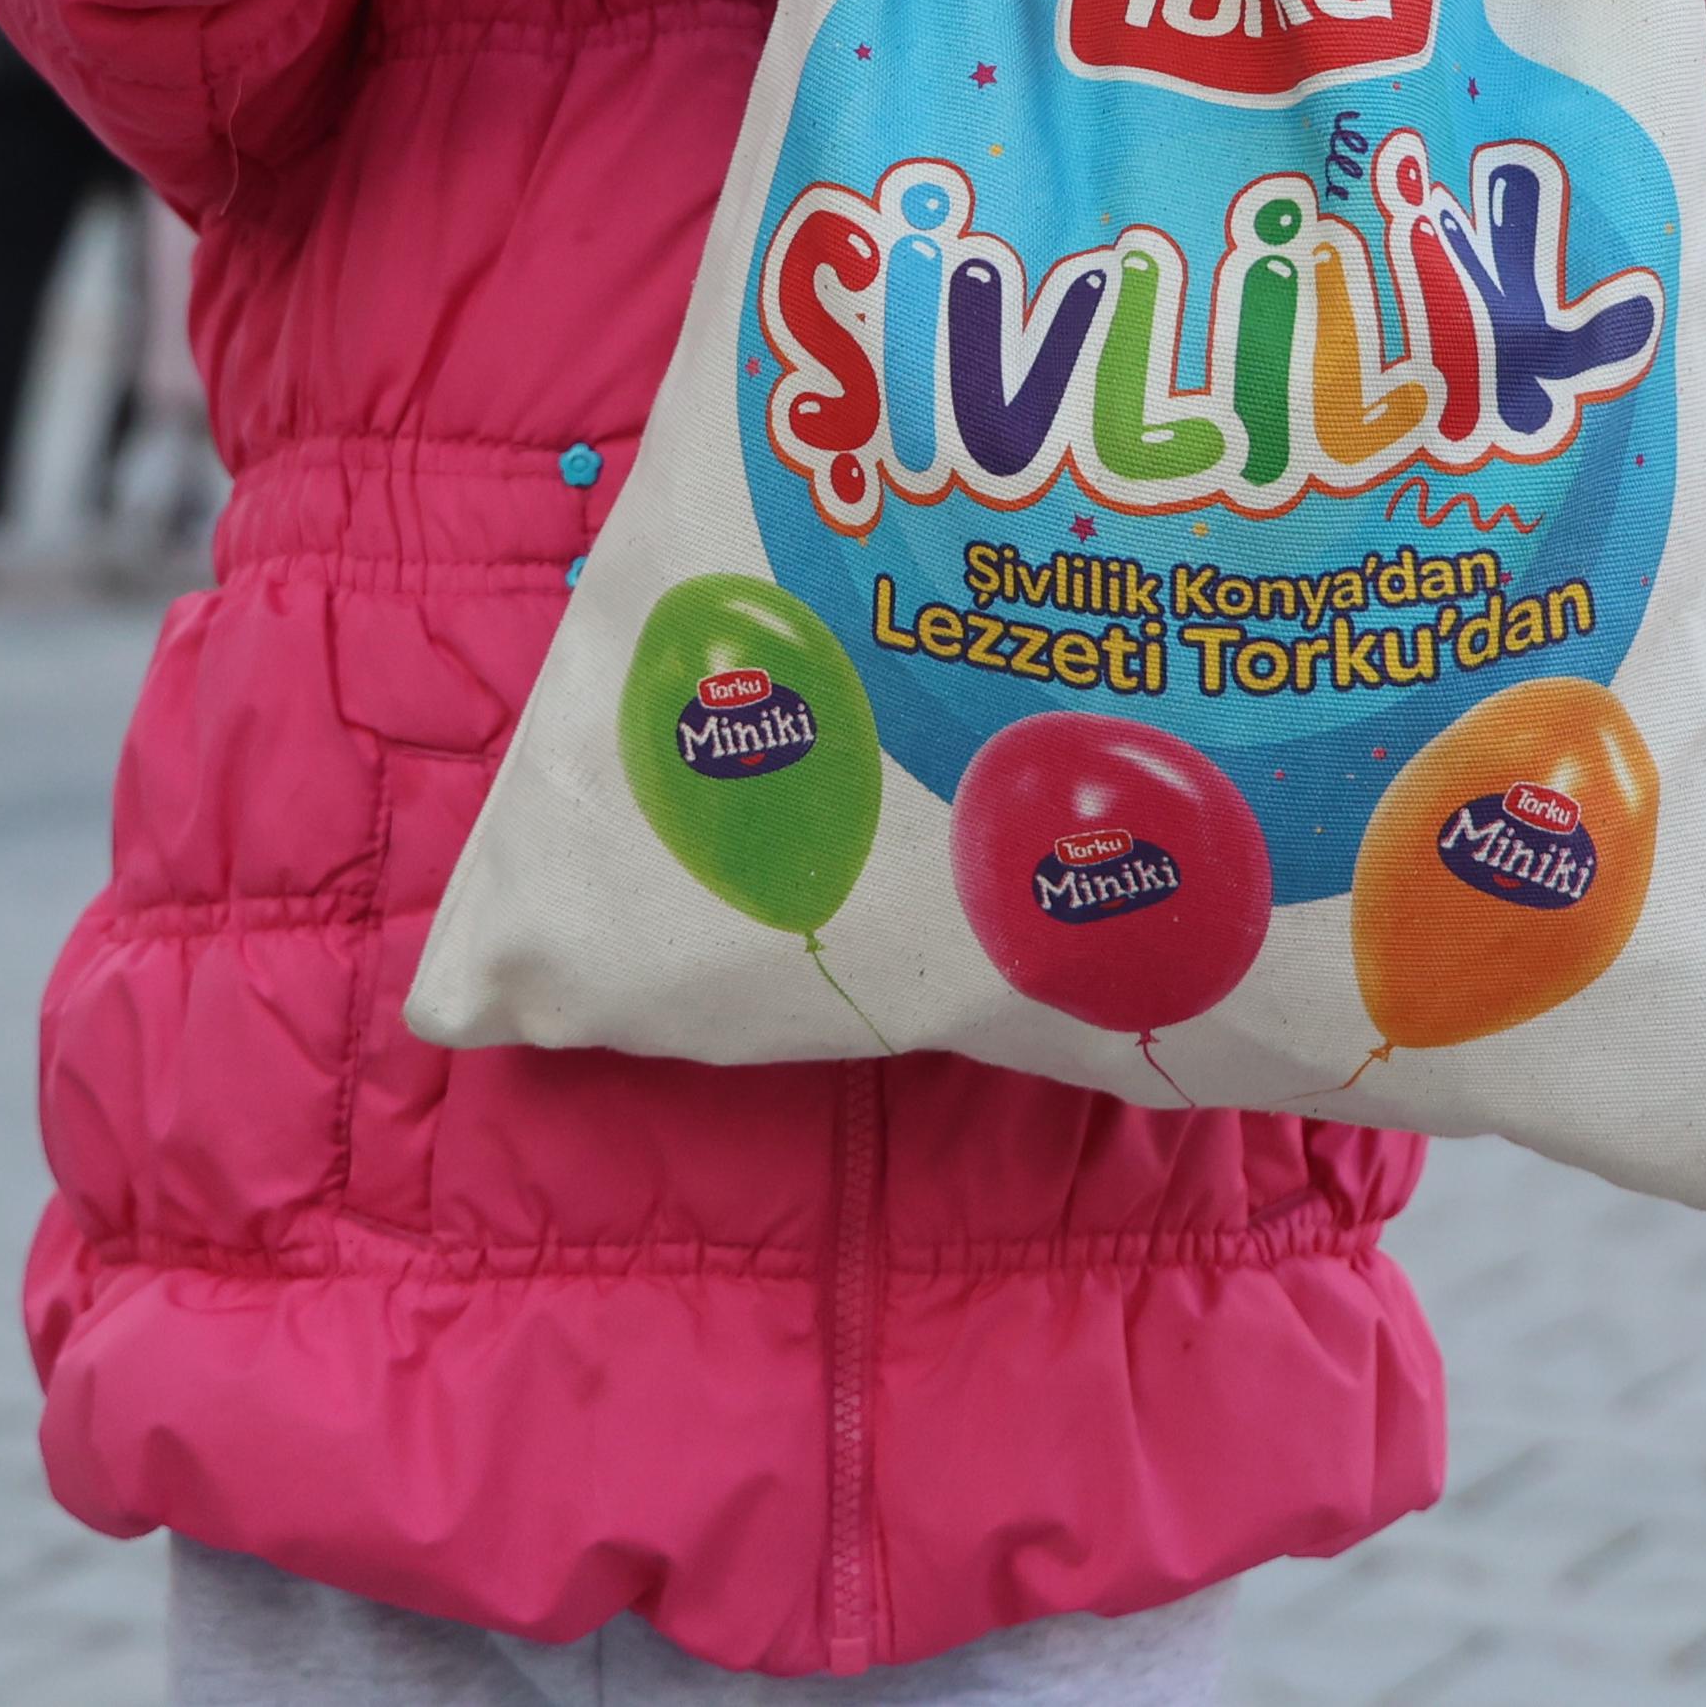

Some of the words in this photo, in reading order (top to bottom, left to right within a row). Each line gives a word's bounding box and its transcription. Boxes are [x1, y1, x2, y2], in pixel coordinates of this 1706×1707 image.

[966, 543, 1161, 615] Şivlilik
[1173, 548, 1498, 627] Konya'dan
[874, 576, 1164, 692] Lezzeti
[1180, 580, 1593, 692] Torku'dan
[706, 677, 763, 701] Torku
[679, 702, 815, 763] Miniki
[1515, 787, 1572, 826] Torku
[1061, 837, 1123, 860] Torku
[1440, 807, 1594, 899] Miniki
[1035, 855, 1180, 911] Miniki
